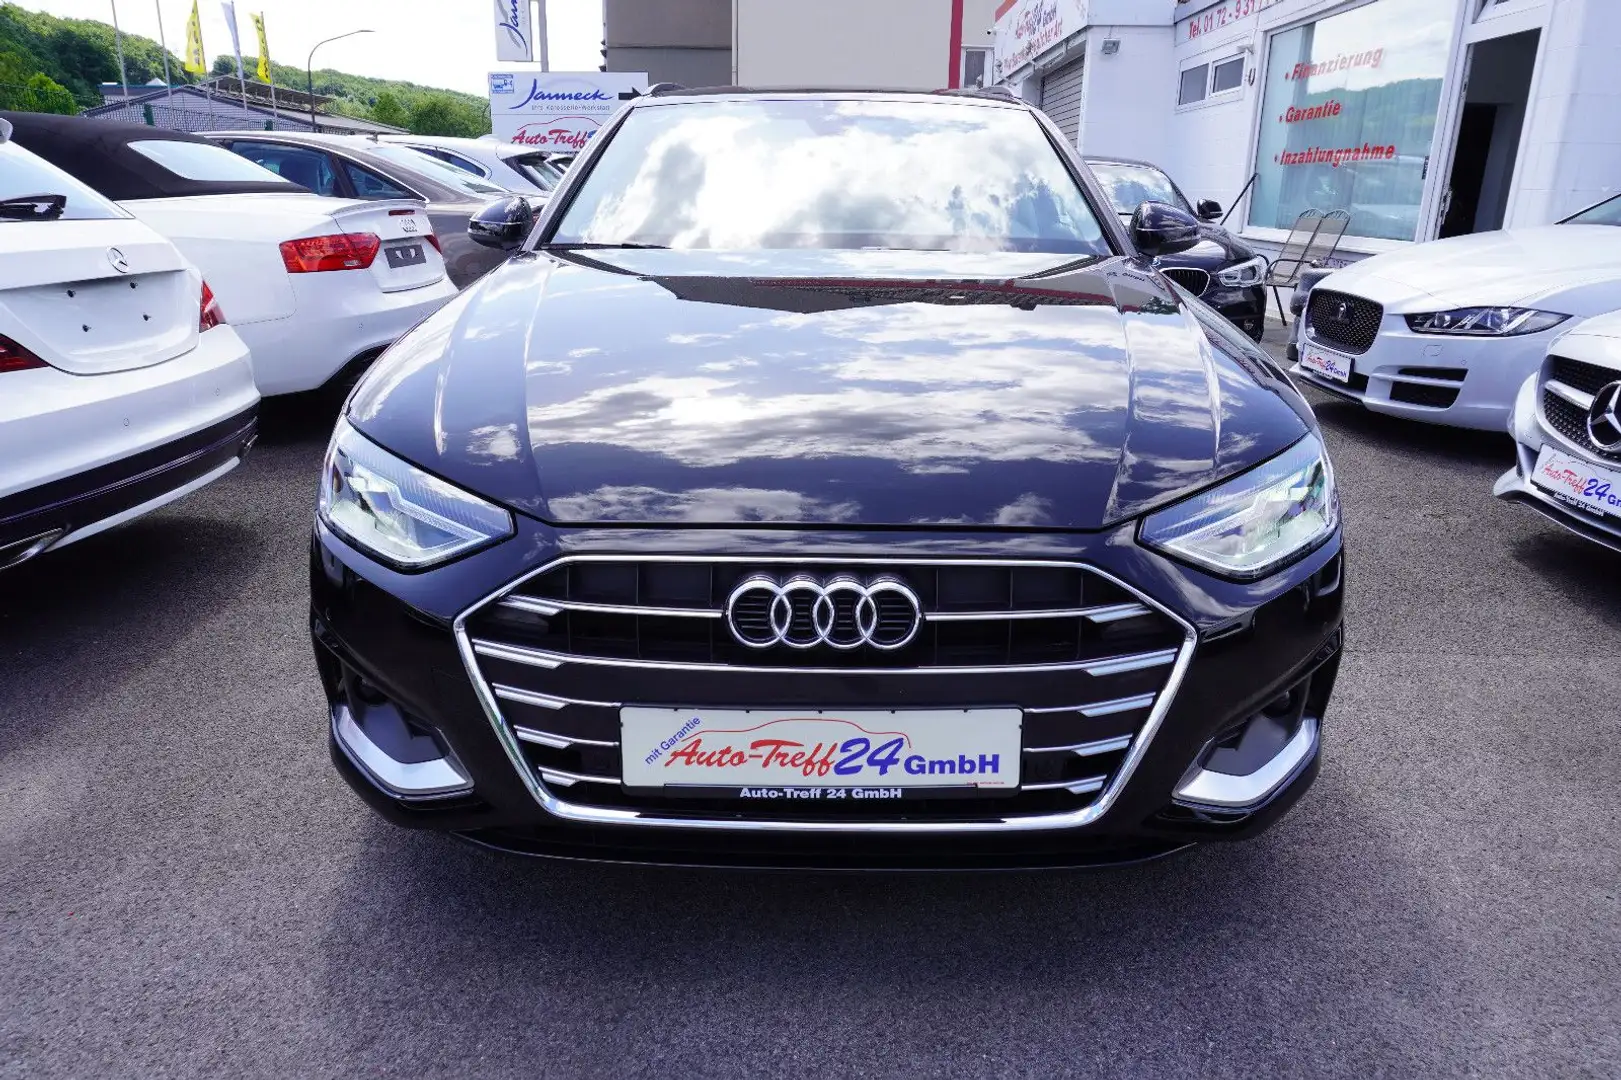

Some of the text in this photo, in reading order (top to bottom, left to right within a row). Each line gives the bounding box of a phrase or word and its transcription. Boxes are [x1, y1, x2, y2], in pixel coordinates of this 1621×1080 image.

[499, 0, 528, 58] Jan
[1189, 17, 1202, 39] Tel.
[1291, 47, 1384, 80] Finanzierung
[508, 78, 615, 110] Janneck
[1285, 100, 1342, 123] Garantie
[511, 129, 598, 149] Auto-Treff
[1279, 142, 1396, 168] Inzahlungnahme
[645, 716, 701, 765] mit Garantie
[904, 754, 1000, 775] GmbH
[739, 788, 902, 799] Auto-Treff 24 GmbH
